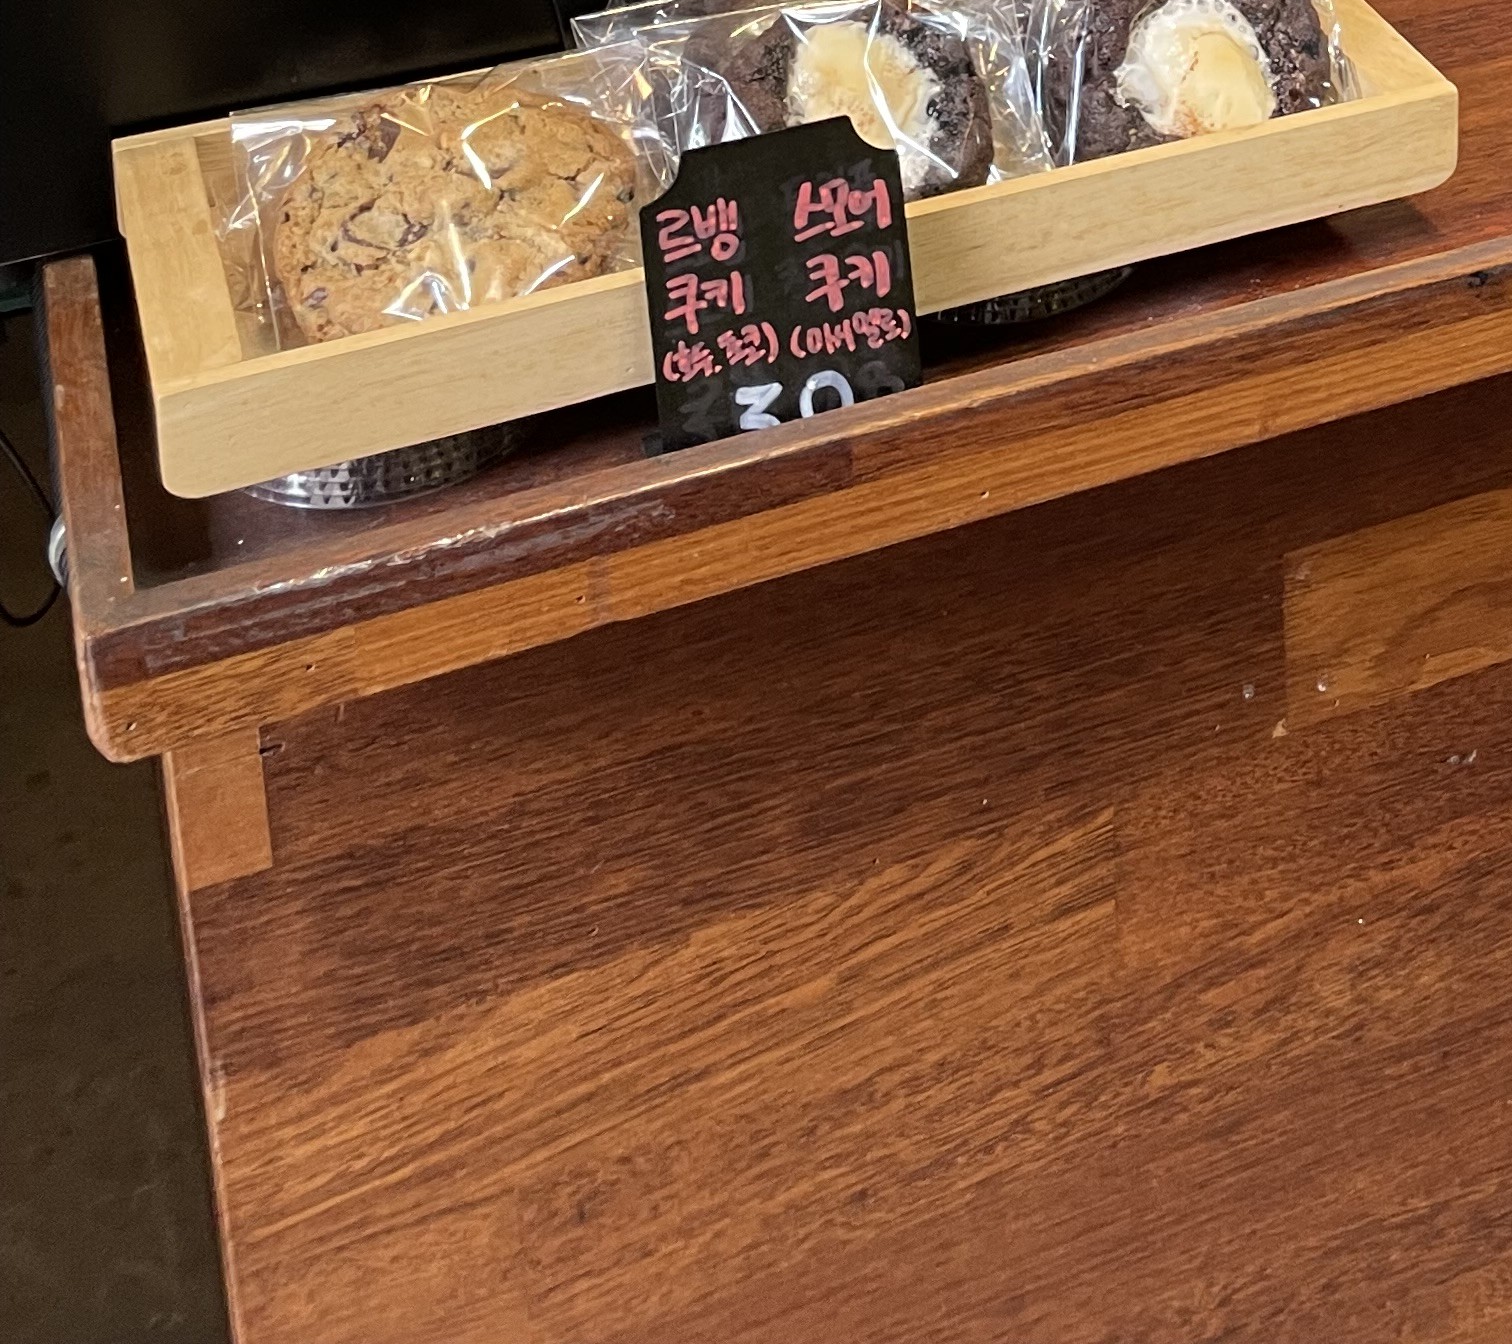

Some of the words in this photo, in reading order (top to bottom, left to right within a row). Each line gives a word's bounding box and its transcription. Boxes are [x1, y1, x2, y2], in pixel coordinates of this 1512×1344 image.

[655, 197, 740, 262] 르뱅
[794, 178, 893, 243] 스모어
[664, 271, 747, 335] 쿠키
[804, 250, 892, 313] 쿠키
